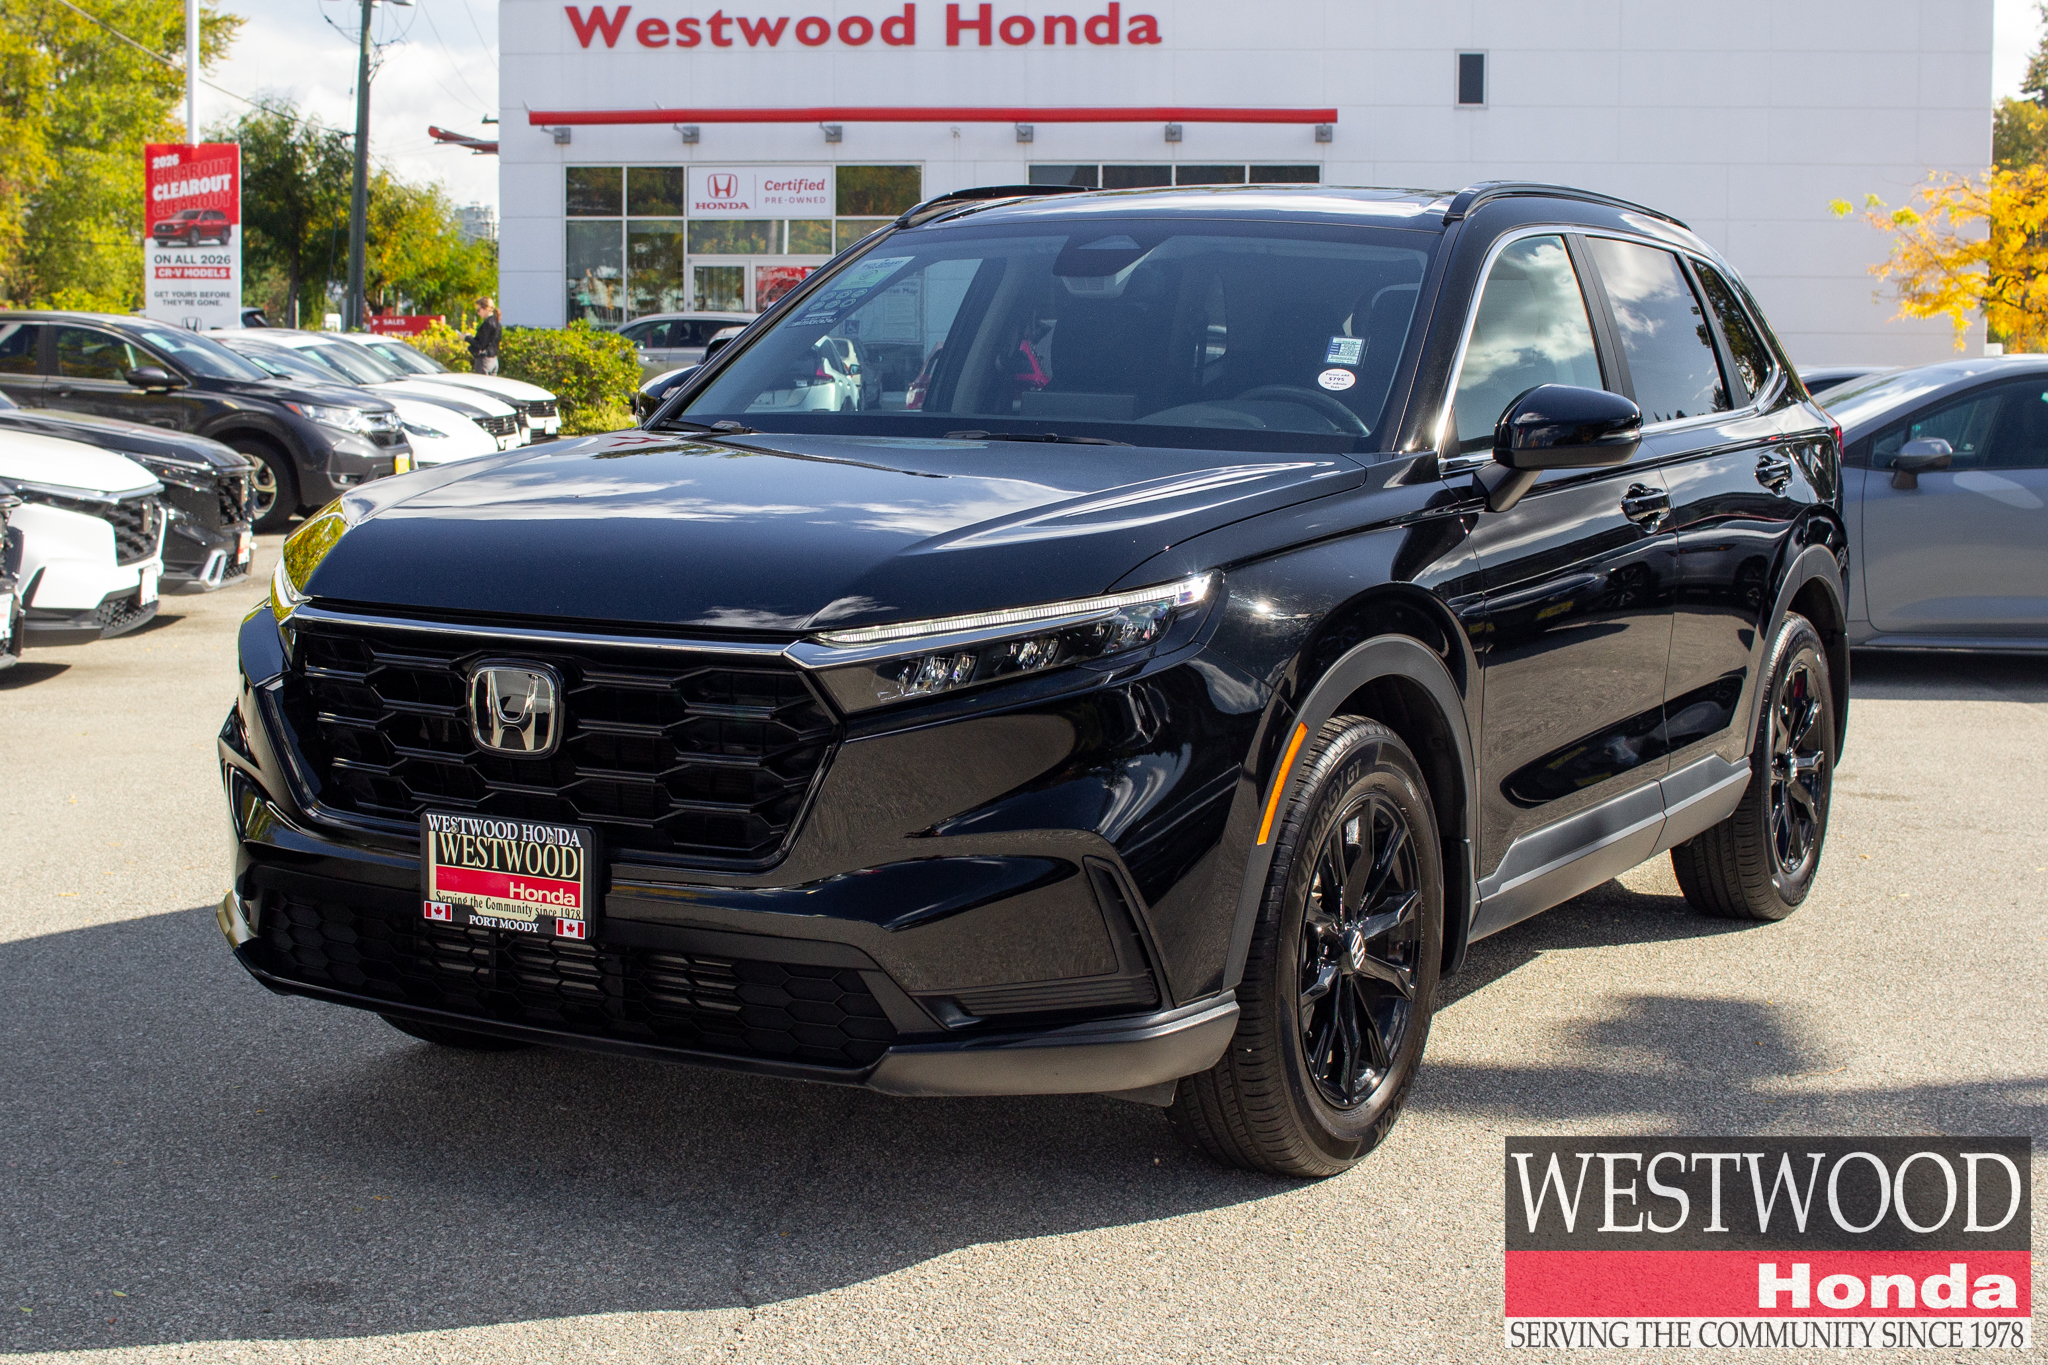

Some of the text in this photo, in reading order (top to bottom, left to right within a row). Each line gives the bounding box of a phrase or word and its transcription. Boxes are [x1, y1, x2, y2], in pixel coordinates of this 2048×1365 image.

[565, 2, 1162, 48] Westwood Honda
[152, 154, 179, 169] 2026
[153, 174, 232, 201] CLEAROUT
[764, 179, 825, 194] Certified
[695, 202, 749, 210] HONDA
[154, 255, 231, 264] ON ALL 2026
[158, 268, 227, 278] CR-V MODELS
[383, 318, 406, 326] SALES
[1347, 758, 1362, 785] GT
[426, 813, 581, 848] WESTWOOD HONDA
[439, 832, 578, 878] WESTWOOD
[509, 881, 576, 906] Honda
[435, 891, 581, 920] Serving the Community since 1978
[469, 915, 539, 933] PORT MOODY
